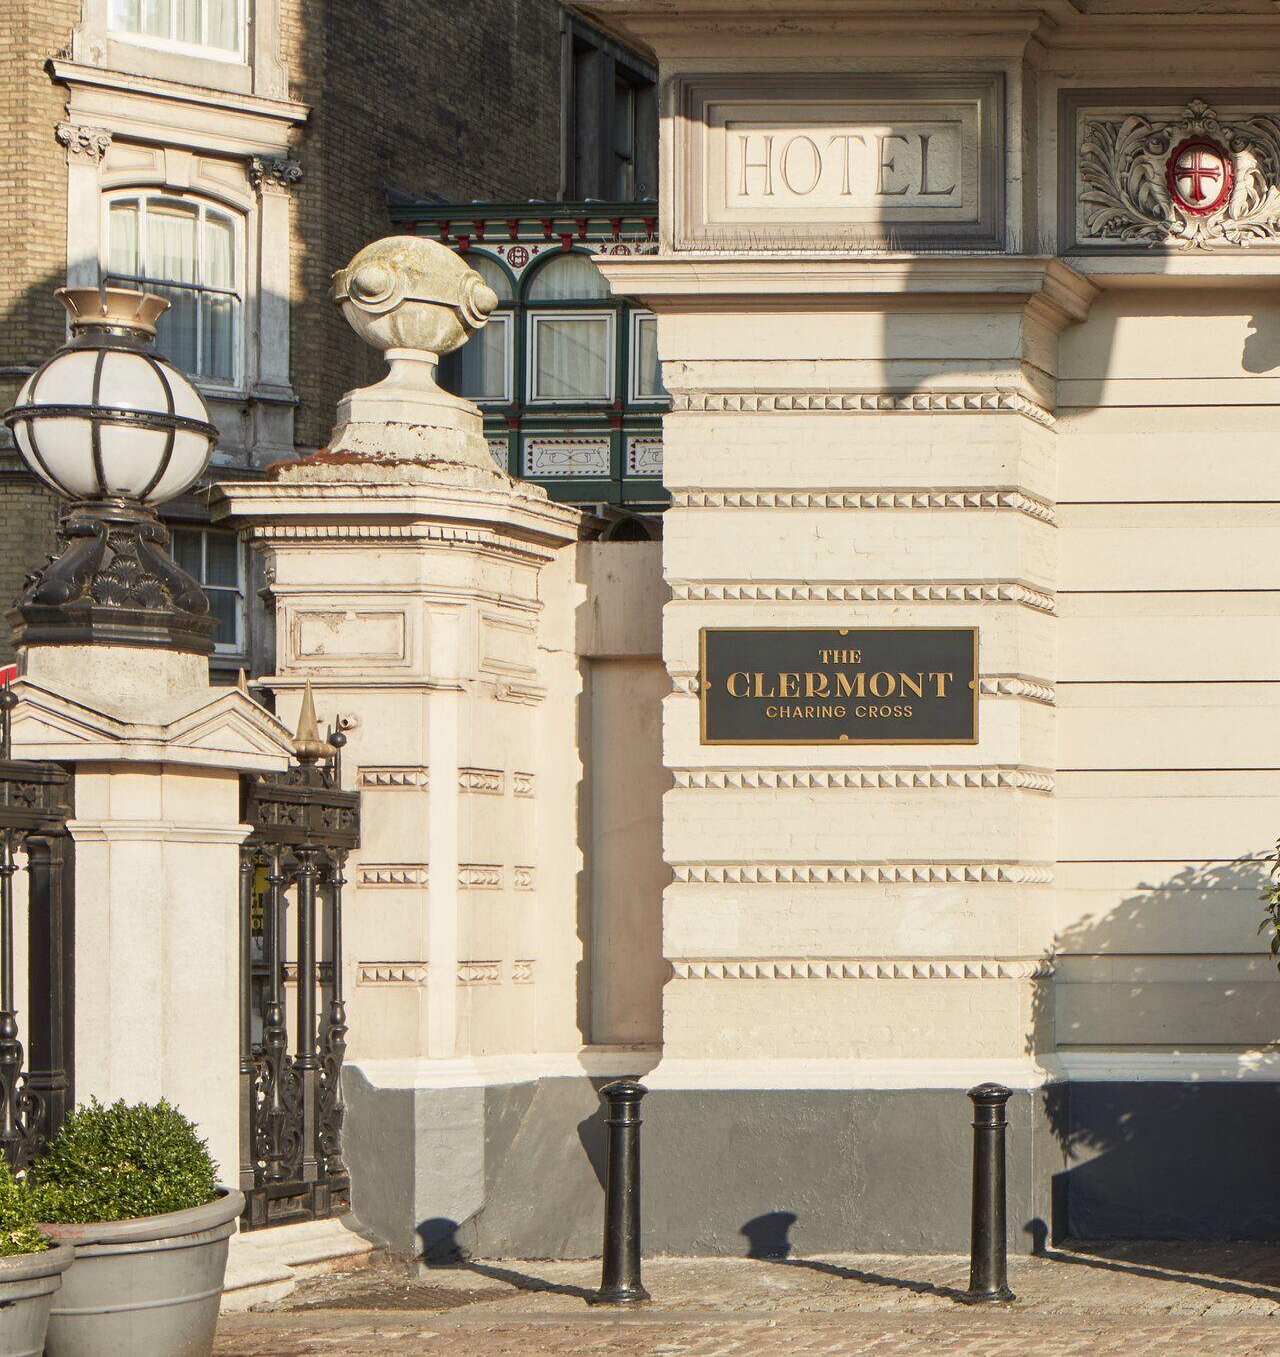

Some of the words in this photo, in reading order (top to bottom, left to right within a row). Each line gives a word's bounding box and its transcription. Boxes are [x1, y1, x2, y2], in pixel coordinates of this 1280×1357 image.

[738, 134, 957, 196] HOTEL
[818, 649, 861, 664] THE
[726, 672, 953, 698] CLERMONT
[765, 705, 847, 719] CHARING
[855, 705, 913, 718] CROSS
